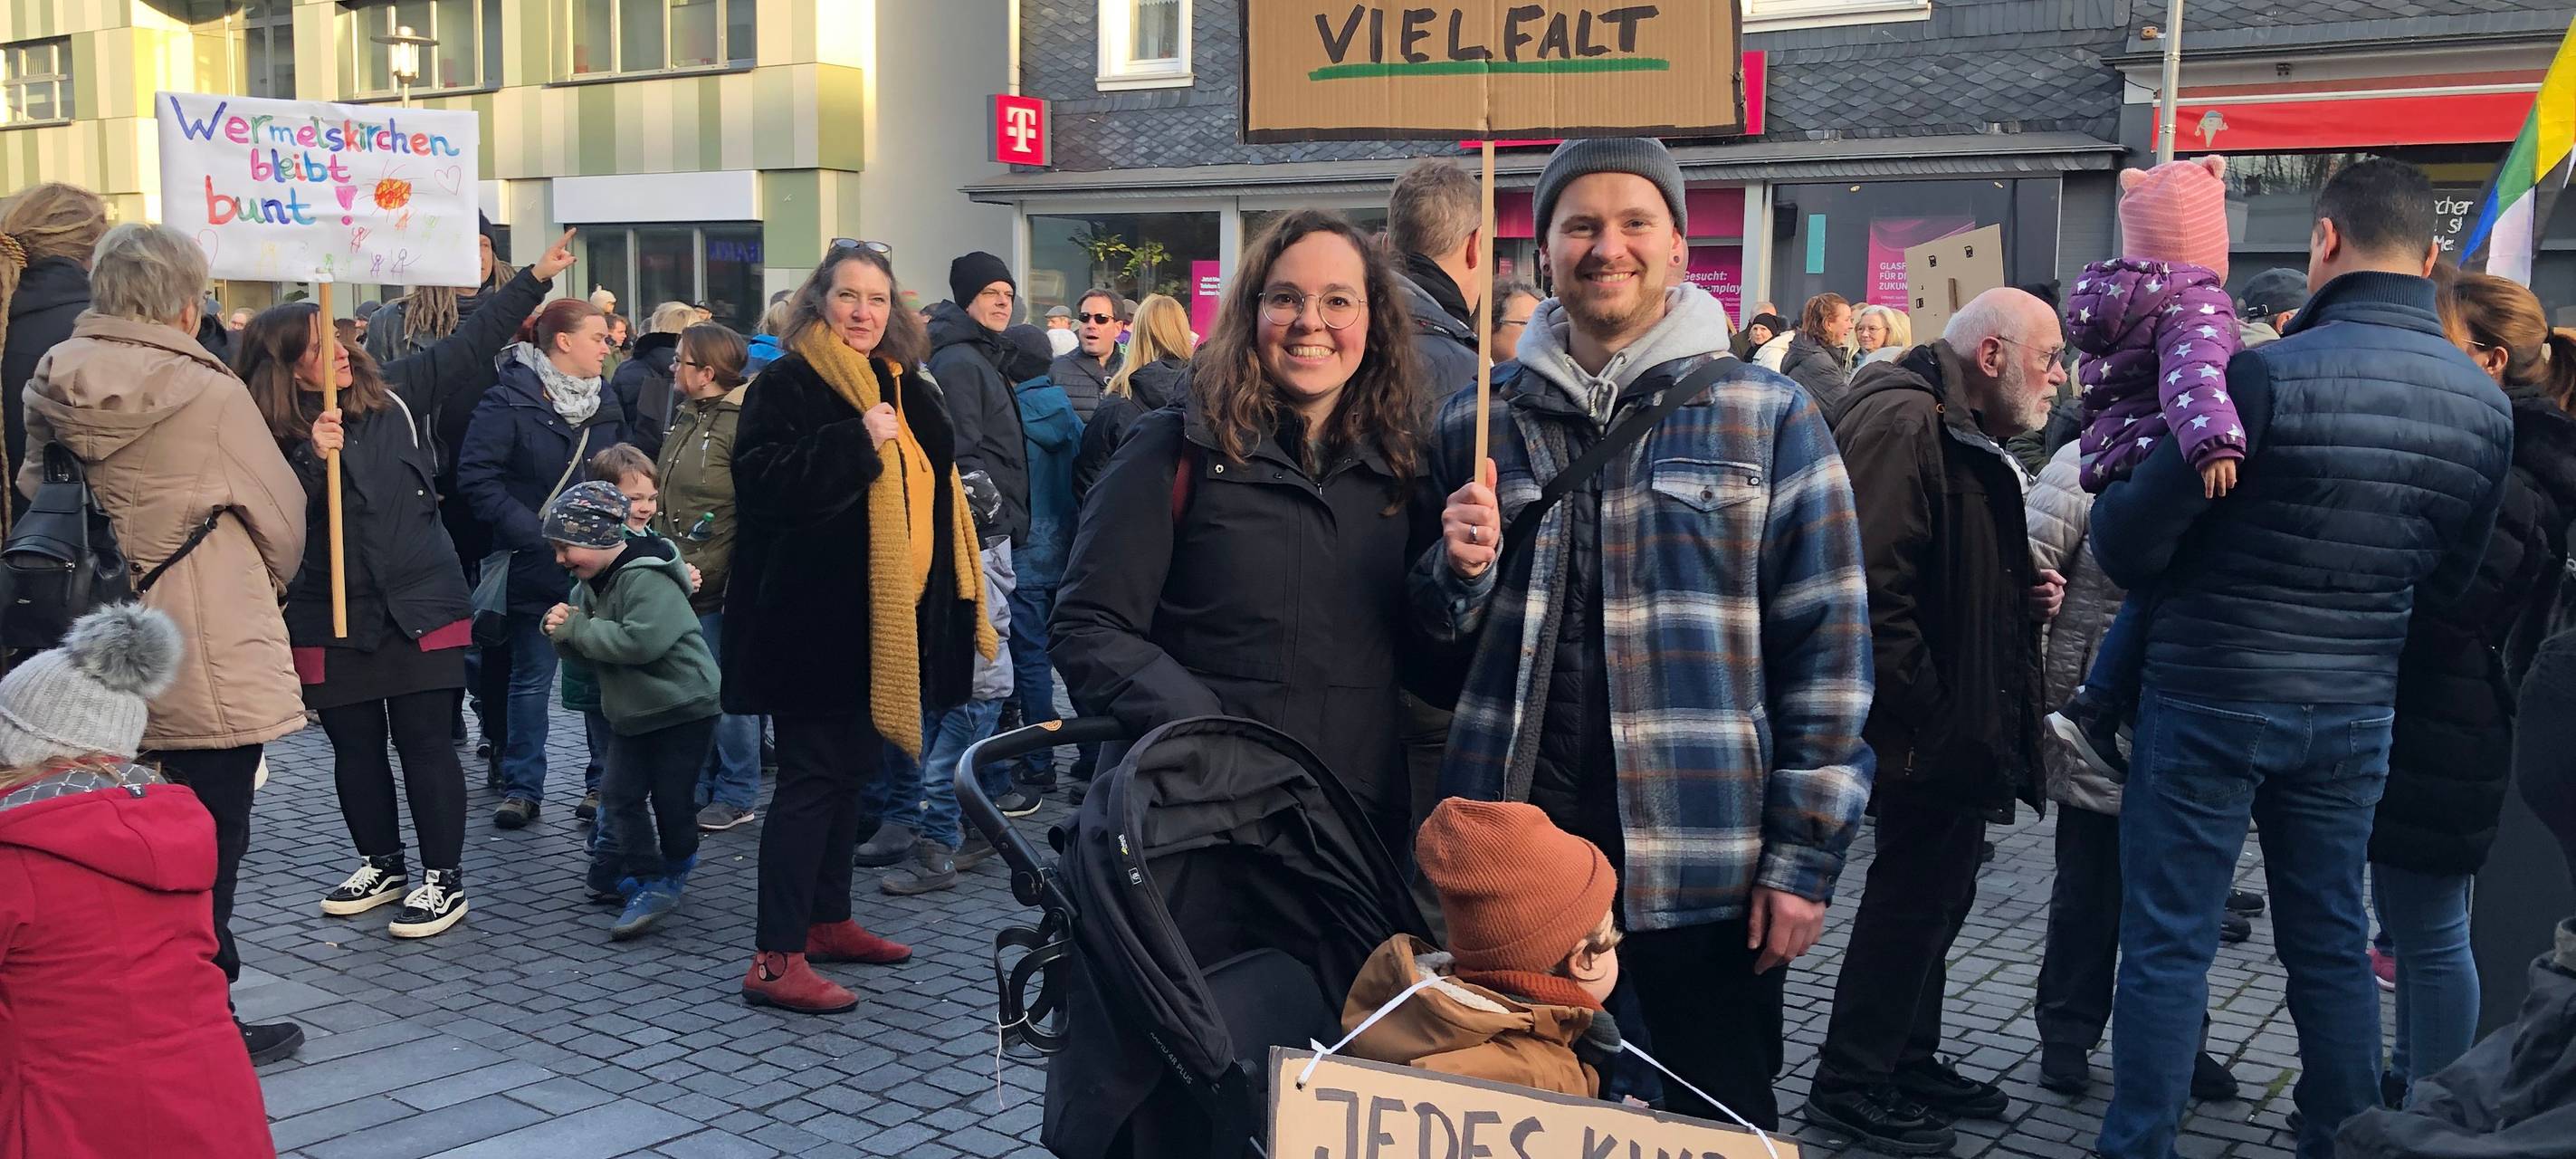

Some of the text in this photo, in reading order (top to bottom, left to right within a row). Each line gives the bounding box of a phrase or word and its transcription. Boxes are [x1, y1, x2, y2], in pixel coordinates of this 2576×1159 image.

[1314, 4, 1660, 64] VIELFALT
[170, 96, 460, 157] Wermelskirchen
[1007, 106, 1035, 153] T
[251, 148, 351, 183] bleibt
[205, 175, 317, 225] bunt
[2434, 196, 2474, 216] cher
[1684, 271, 1728, 281] Gesucht:
[1699, 283, 1741, 295] mplay
[1879, 271, 1896, 280] FÜR
[1177, 1063, 1193, 1085] PLUS
